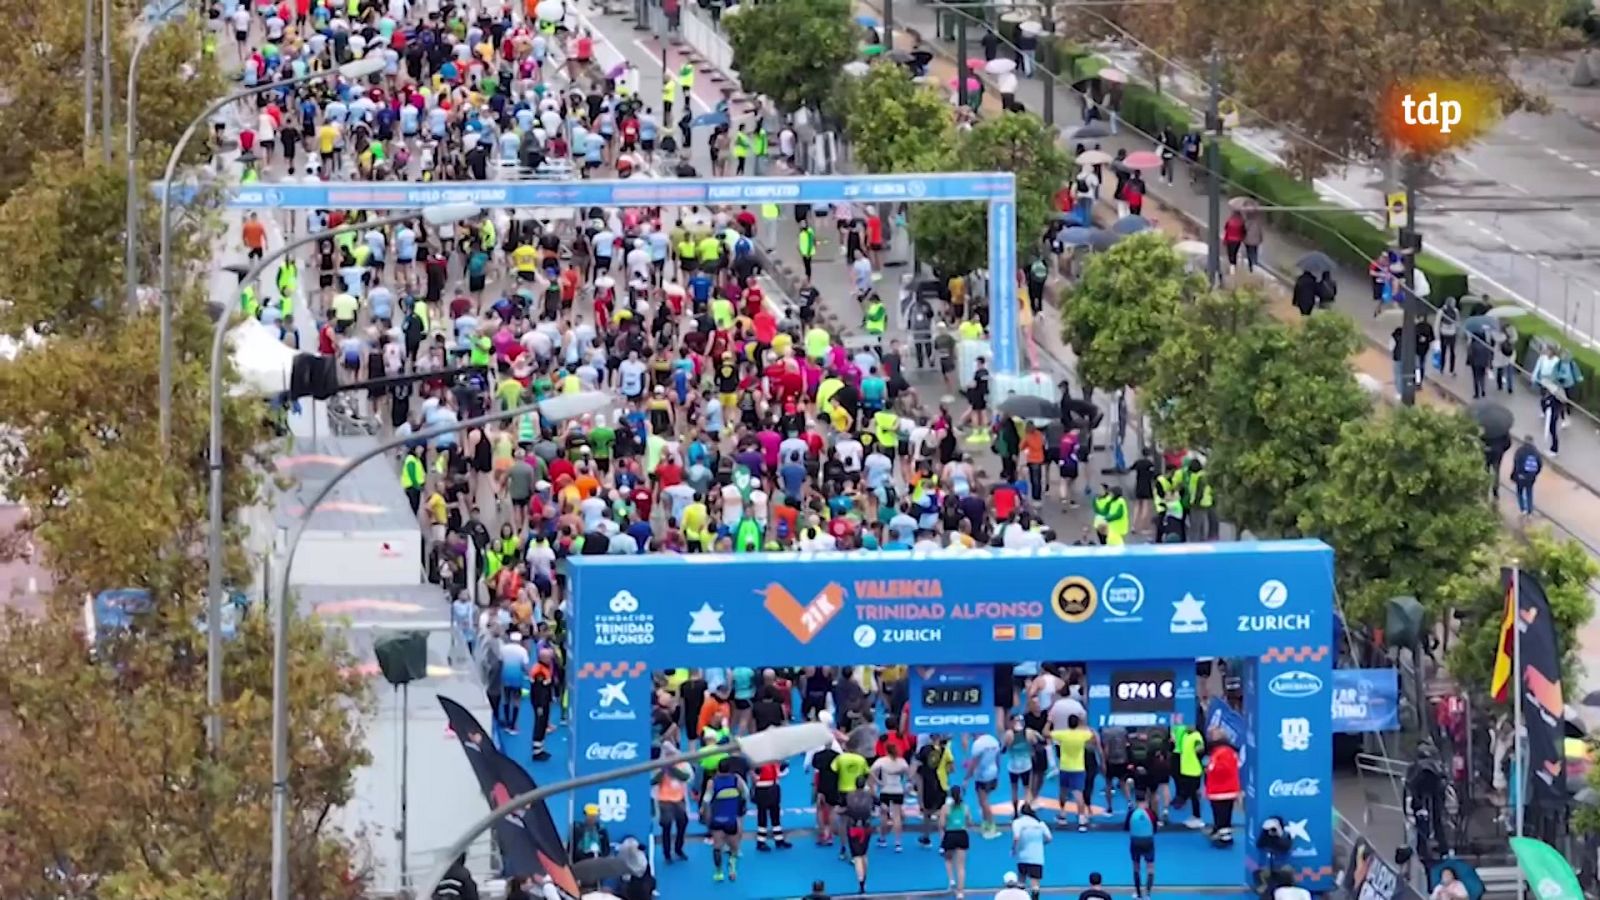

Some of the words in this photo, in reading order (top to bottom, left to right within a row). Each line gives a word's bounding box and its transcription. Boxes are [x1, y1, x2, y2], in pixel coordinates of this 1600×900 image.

[854, 579, 942, 598] VALENCIA
[801, 593, 835, 633] 21K
[855, 604, 945, 620] TRINIDAD
[951, 601, 1044, 618] ALFONSO
[595, 623, 654, 634] TRINIDAD
[1237, 614, 1310, 632] ZURICH
[595, 634, 655, 645] ALFONSO
[882, 628, 941, 643] ZURICH
[914, 714, 990, 726] COROS
